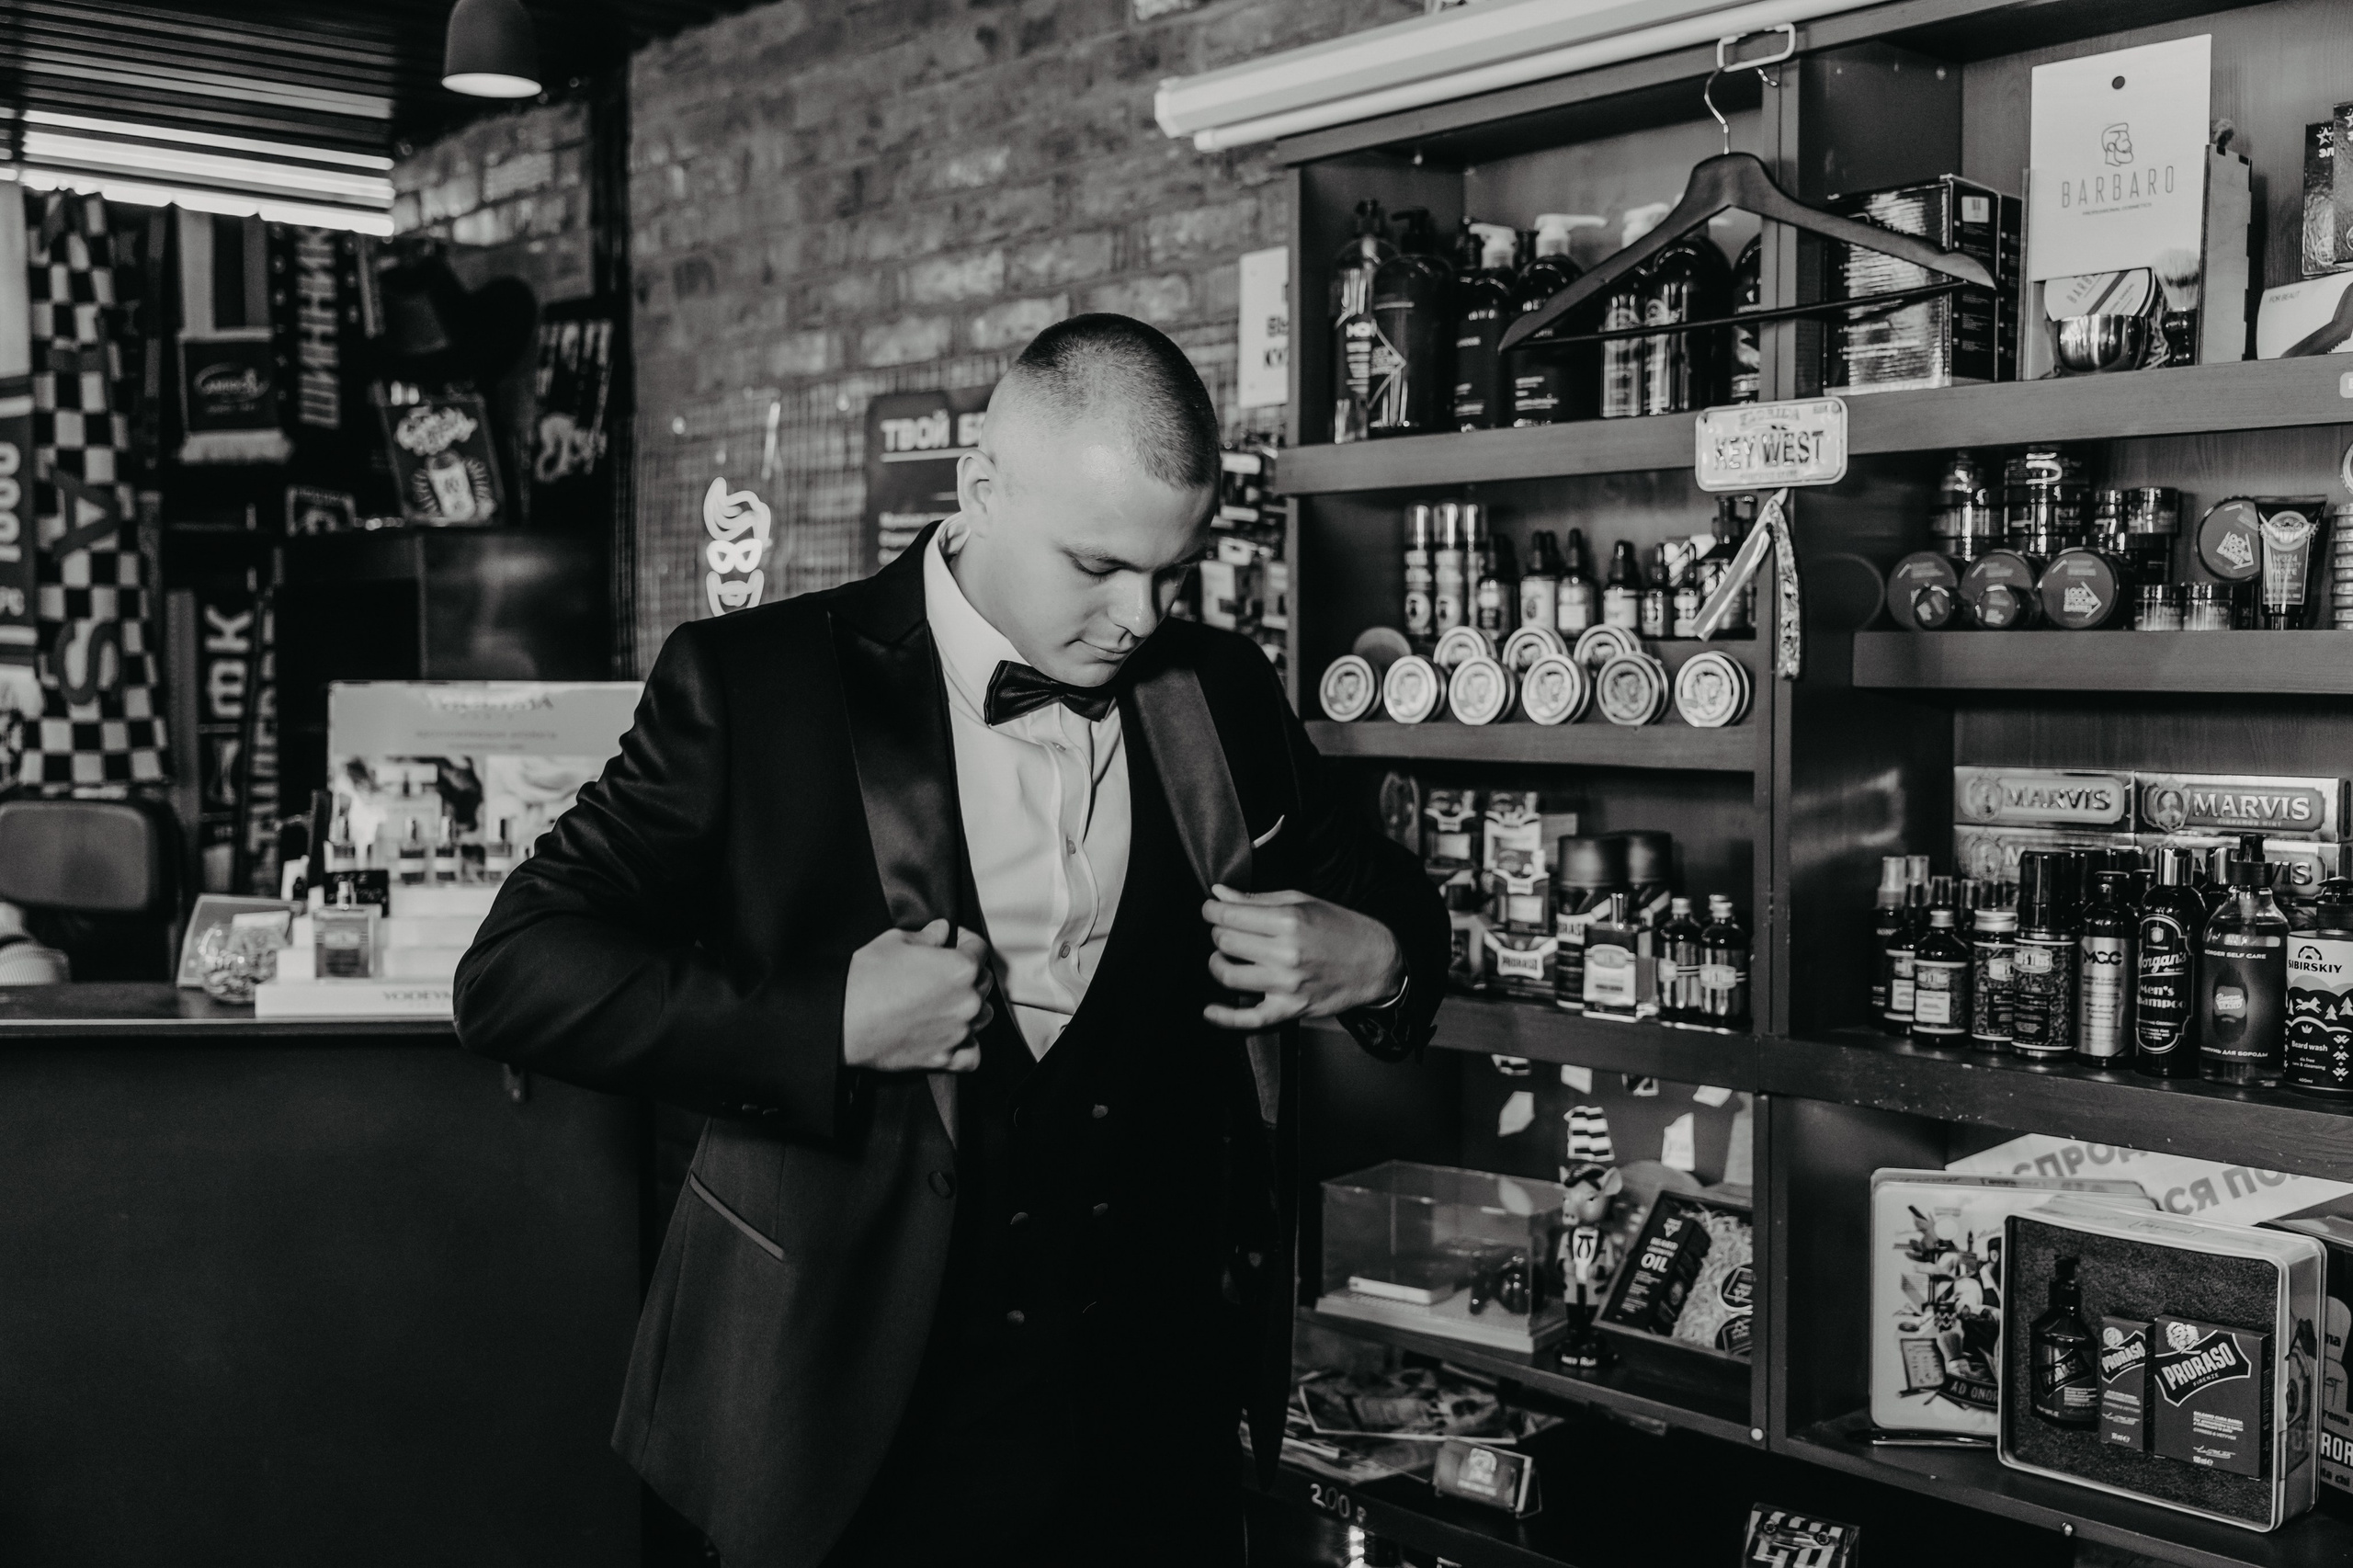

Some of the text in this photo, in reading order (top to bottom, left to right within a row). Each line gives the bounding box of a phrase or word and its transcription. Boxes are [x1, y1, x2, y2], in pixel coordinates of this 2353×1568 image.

[2062, 165, 2175, 209] BARBARO
[2066, 276, 2094, 304] BARB
[880, 409, 950, 451] ТВОЙ
[1713, 430, 1824, 471] KEY WEST
[2006, 787, 2111, 811] MARVIS
[2193, 793, 2311, 821] MARVIS
[2288, 959, 2343, 973] SIBIRSKIY
[2291, 1040, 2328, 1052] Beard wash
[1641, 1253, 1668, 1274] OIL
[2101, 1341, 2146, 1373] PRORASO
[2161, 1341, 2237, 1391] PRORASO
[1949, 1381, 1998, 1402] AD ONOR
[2192, 1372, 2220, 1387] FIRENZE
[2321, 1431, 2353, 1467] ROR
[1311, 1483, 1351, 1518] 200
